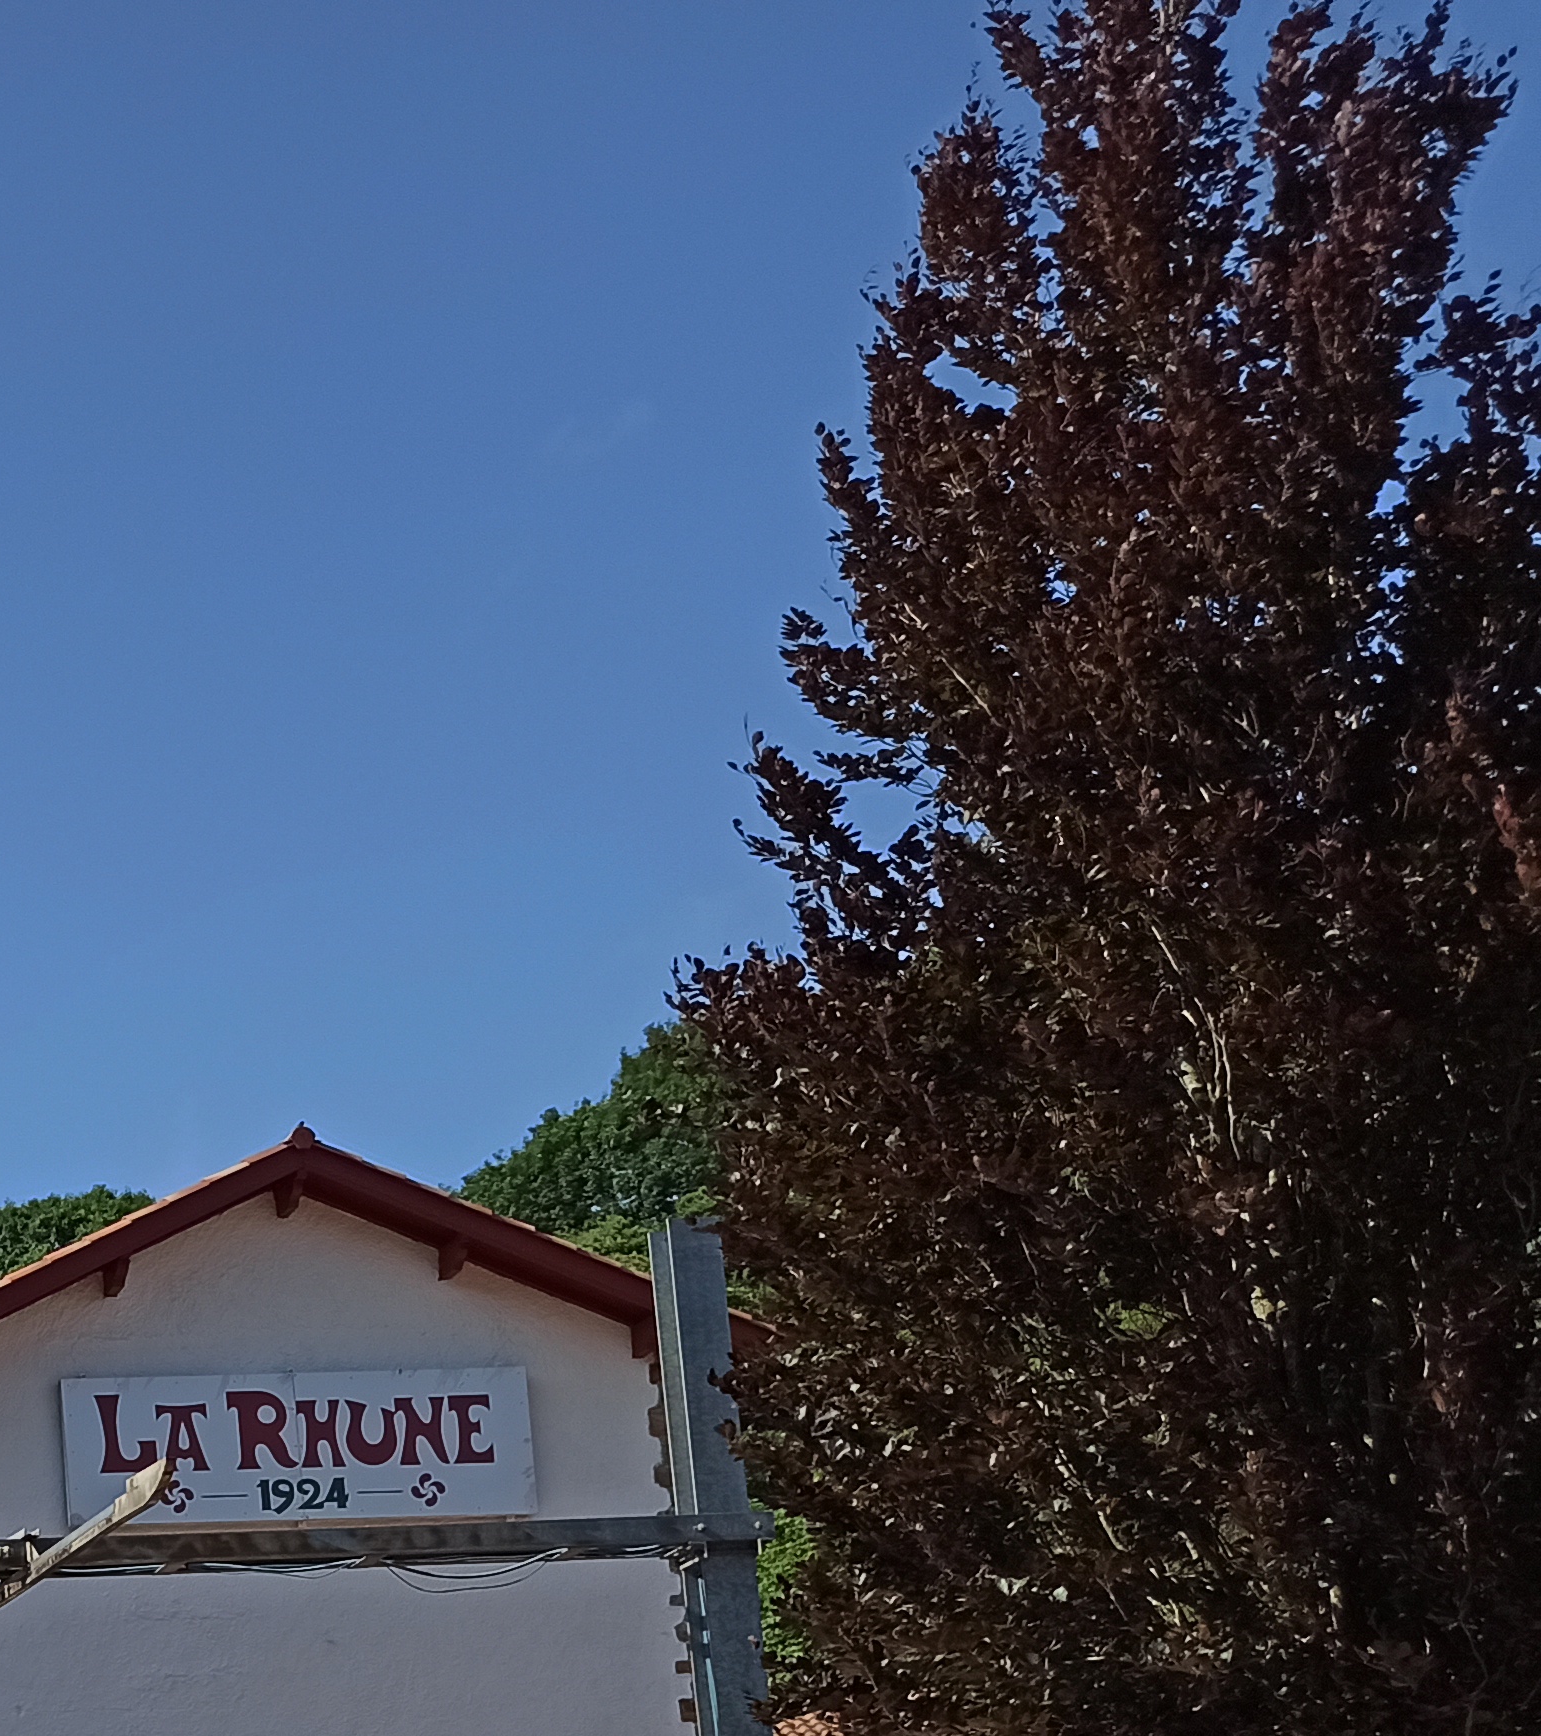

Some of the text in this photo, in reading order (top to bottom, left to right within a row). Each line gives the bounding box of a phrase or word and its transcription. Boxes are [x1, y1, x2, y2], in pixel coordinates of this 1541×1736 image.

[93, 1390, 495, 1474] LA RHUNE
[256, 1477, 349, 1514] 1924
